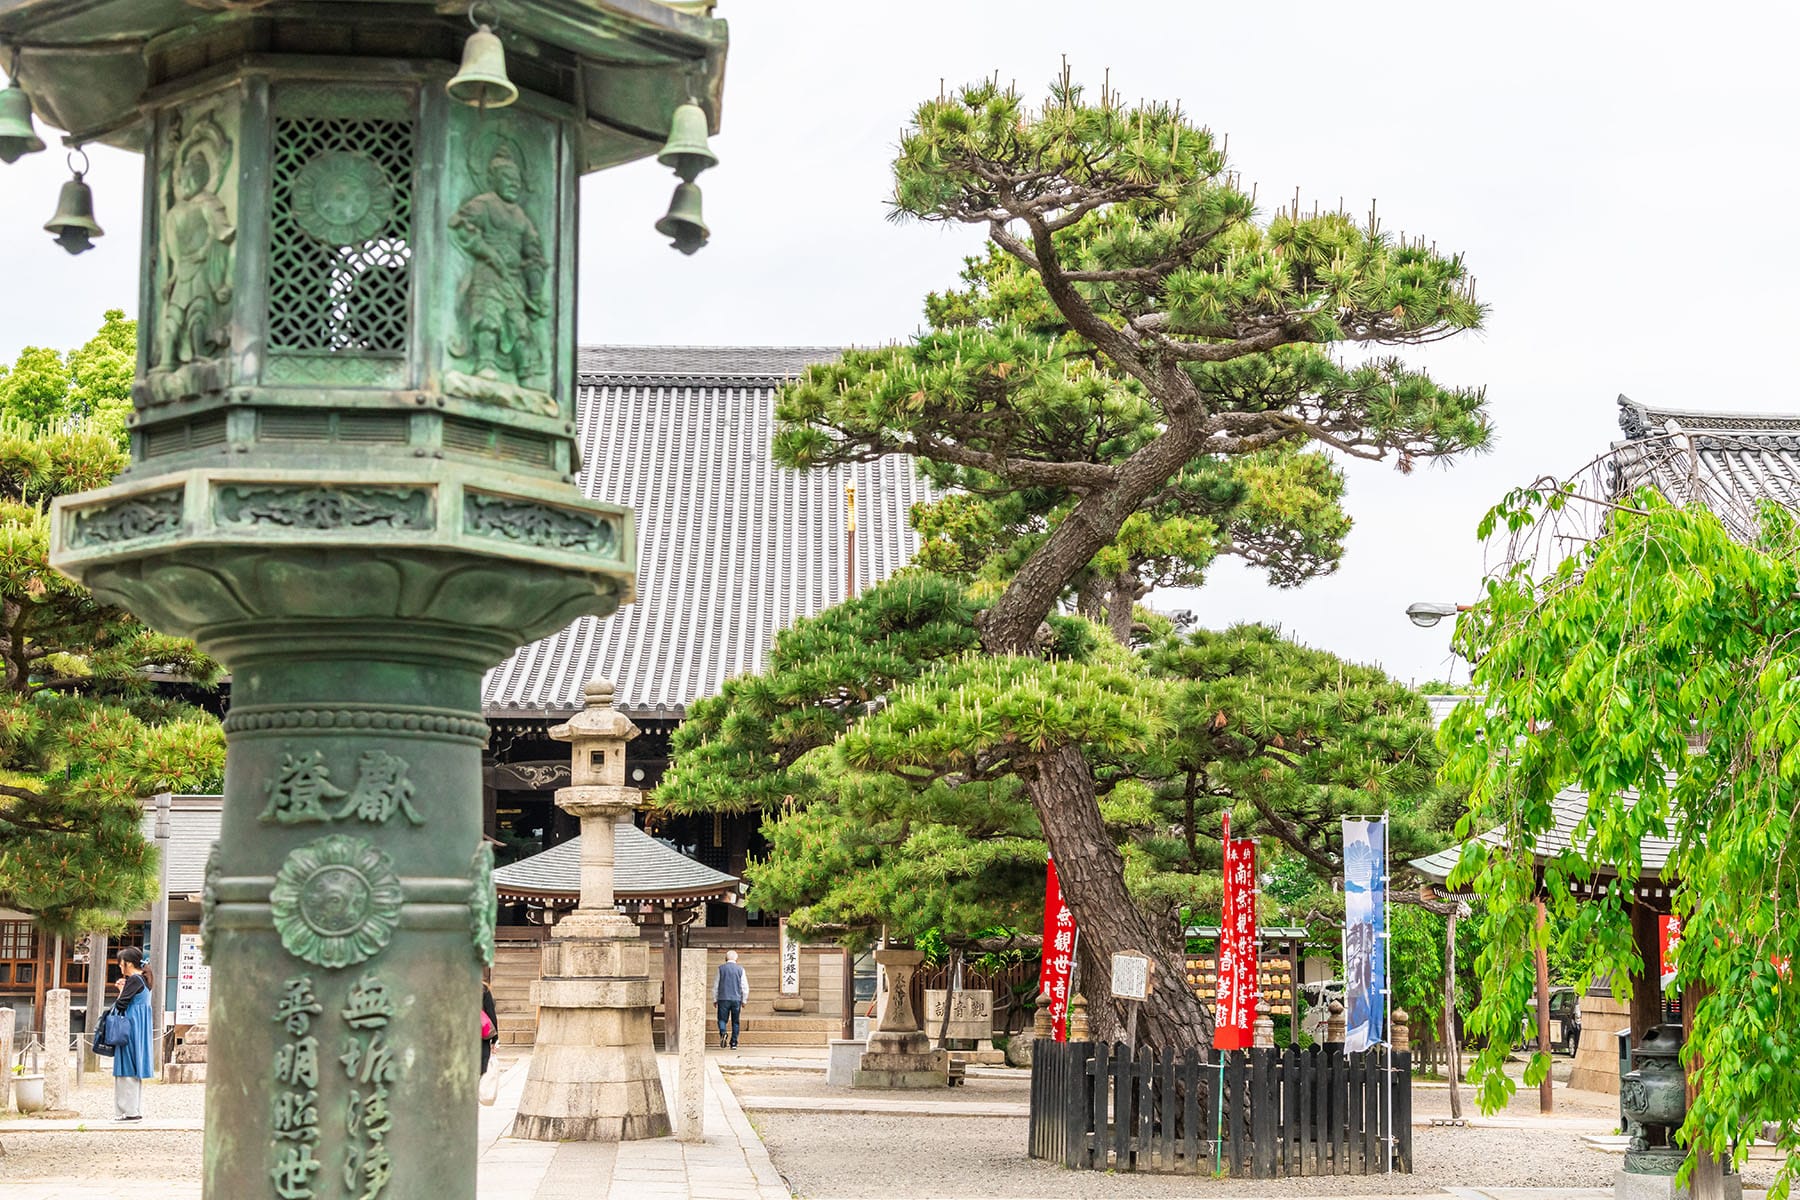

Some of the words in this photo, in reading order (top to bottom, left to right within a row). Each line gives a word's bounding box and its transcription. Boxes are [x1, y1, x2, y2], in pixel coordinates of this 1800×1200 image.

[1235, 861, 1248, 1029] 南無観世音菩薩
